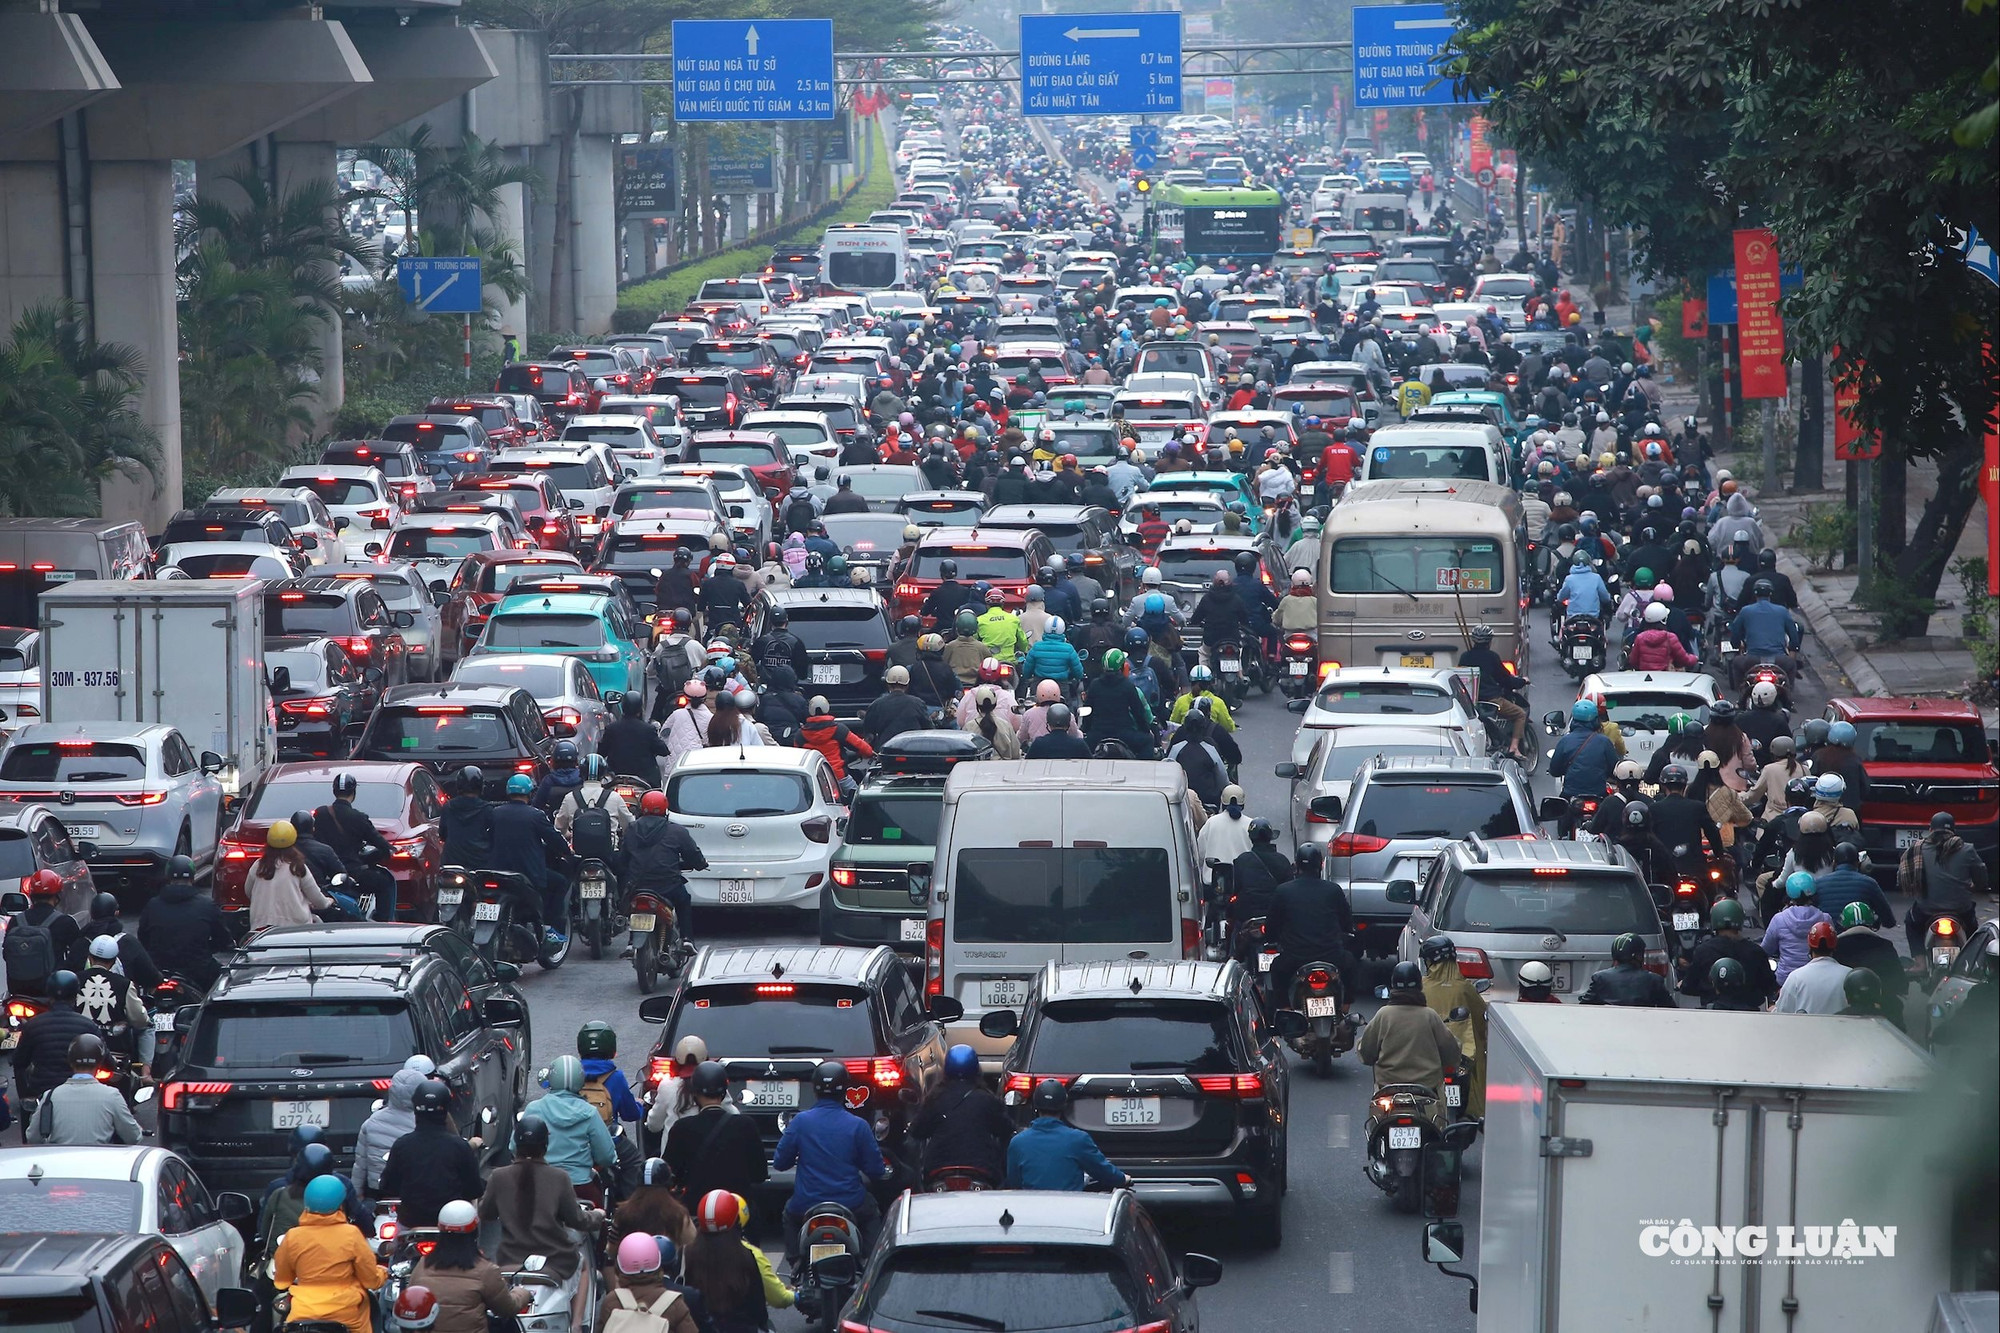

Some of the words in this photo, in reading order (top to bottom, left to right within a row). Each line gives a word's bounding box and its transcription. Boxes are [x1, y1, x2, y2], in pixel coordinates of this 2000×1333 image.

[1358, 42, 1392, 58] ĐƯỜNG
[1395, 41, 1433, 56] TRƯỜNG
[678, 57, 696, 71] NÚT
[699, 60, 720, 71] GIAO
[724, 57, 742, 71] NGÃ
[747, 59, 760, 71] TƯ
[764, 56, 776, 71] SỞ
[1029, 52, 1062, 66] ĐƯỜNG
[1065, 51, 1090, 66] LÁNG
[1158, 53, 1173, 64] km
[1360, 64, 1378, 78] NÚT
[1381, 66, 1402, 78] GIAO
[1406, 64, 1425, 77] NGÃ
[1030, 72, 1048, 87] NÚT
[1052, 75, 1072, 86] GIAO
[1076, 71, 1095, 86] CẦU
[1099, 70, 1119, 86] GIẤY
[1149, 73, 1155, 84] 5
[1158, 73, 1173, 84] km
[678, 78, 696, 92] NÚT
[699, 80, 720, 92] GIAO
[724, 78, 730, 92] Ô
[734, 80, 753, 93] CHỢ
[757, 76, 776, 91] DỪA
[815, 80, 830, 90] km
[1360, 84, 1378, 99] CẦU
[1382, 85, 1405, 98] VĨNH
[679, 98, 696, 112] VĂN
[700, 97, 722, 112] MIẾU
[725, 96, 750, 112] QUỐC
[752, 96, 764, 112] TỬ
[768, 97, 791, 111] GIÁM
[815, 100, 830, 111] km
[1030, 92, 1048, 107] CẦU
[1052, 94, 1076, 108] NHẬT
[1081, 93, 1100, 106] TÂN
[1146, 94, 1155, 105] 11
[1159, 94, 1174, 104] km
[1406, 386, 1421, 398] be
[1377, 451, 1388, 460] 01
[1467, 580, 1484, 589] 6.2
[52, 672, 74, 686] 30M
[84, 672, 119, 686] 937.56
[66, 826, 94, 836] 39.59
[728, 881, 746, 892] 30A
[721, 892, 753, 903] 960.94
[913, 921, 926, 930] 30
[905, 931, 926, 940] 944.
[994, 983, 1015, 992] 98B
[988, 994, 1024, 1004] 108.47
[762, 1082, 784, 1092] 30G
[290, 1102, 312, 1113] 30K
[1121, 1098, 1144, 1110] 30A
[280, 1115, 322, 1126] 87244
[1112, 1111, 1154, 1122] 651.12
[1391, 1137, 1419, 1147] 482.79
